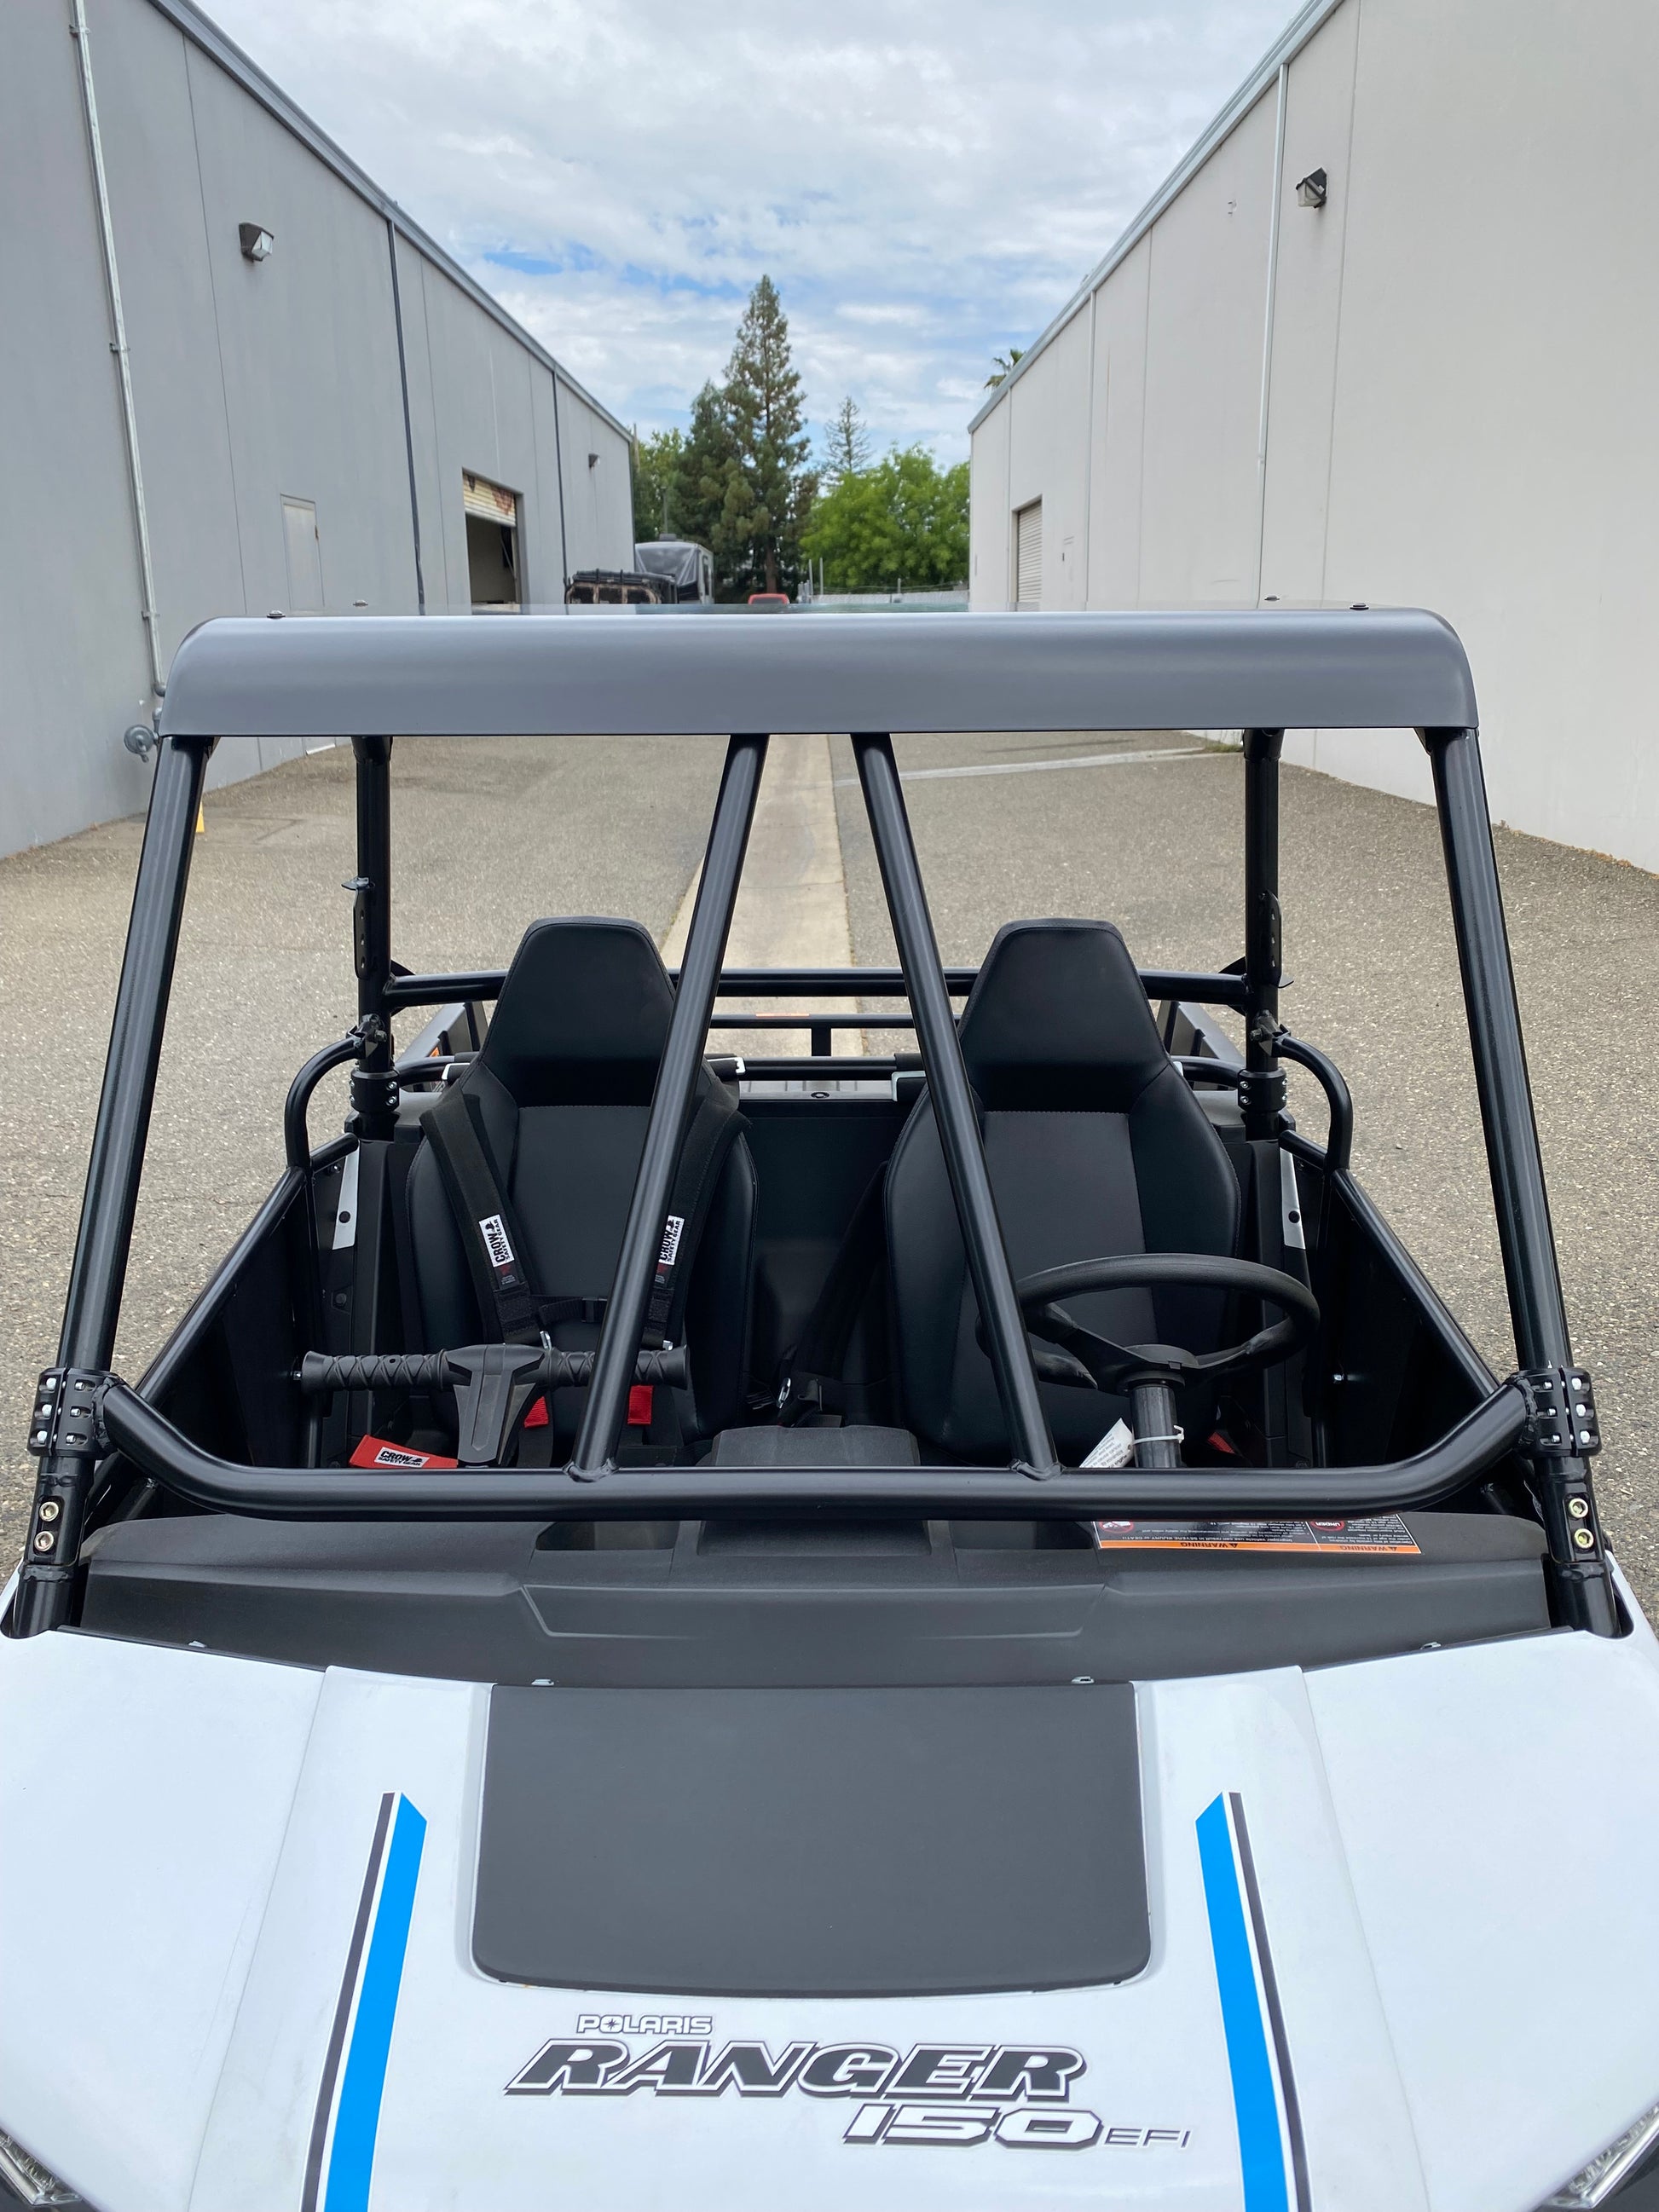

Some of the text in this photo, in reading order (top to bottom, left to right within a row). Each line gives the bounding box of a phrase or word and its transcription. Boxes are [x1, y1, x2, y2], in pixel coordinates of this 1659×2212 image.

[488, 1233, 506, 1262] CROW
[494, 1219, 510, 1260] SAFETY GEAR
[667, 1221, 681, 1262] SAFETY GEAR
[381, 1451, 412, 1462] CROW
[576, 2014, 713, 2035] POLARIS
[504, 2038, 1088, 2103] RANGER
[843, 2103, 1193, 2151] 150 EFI
